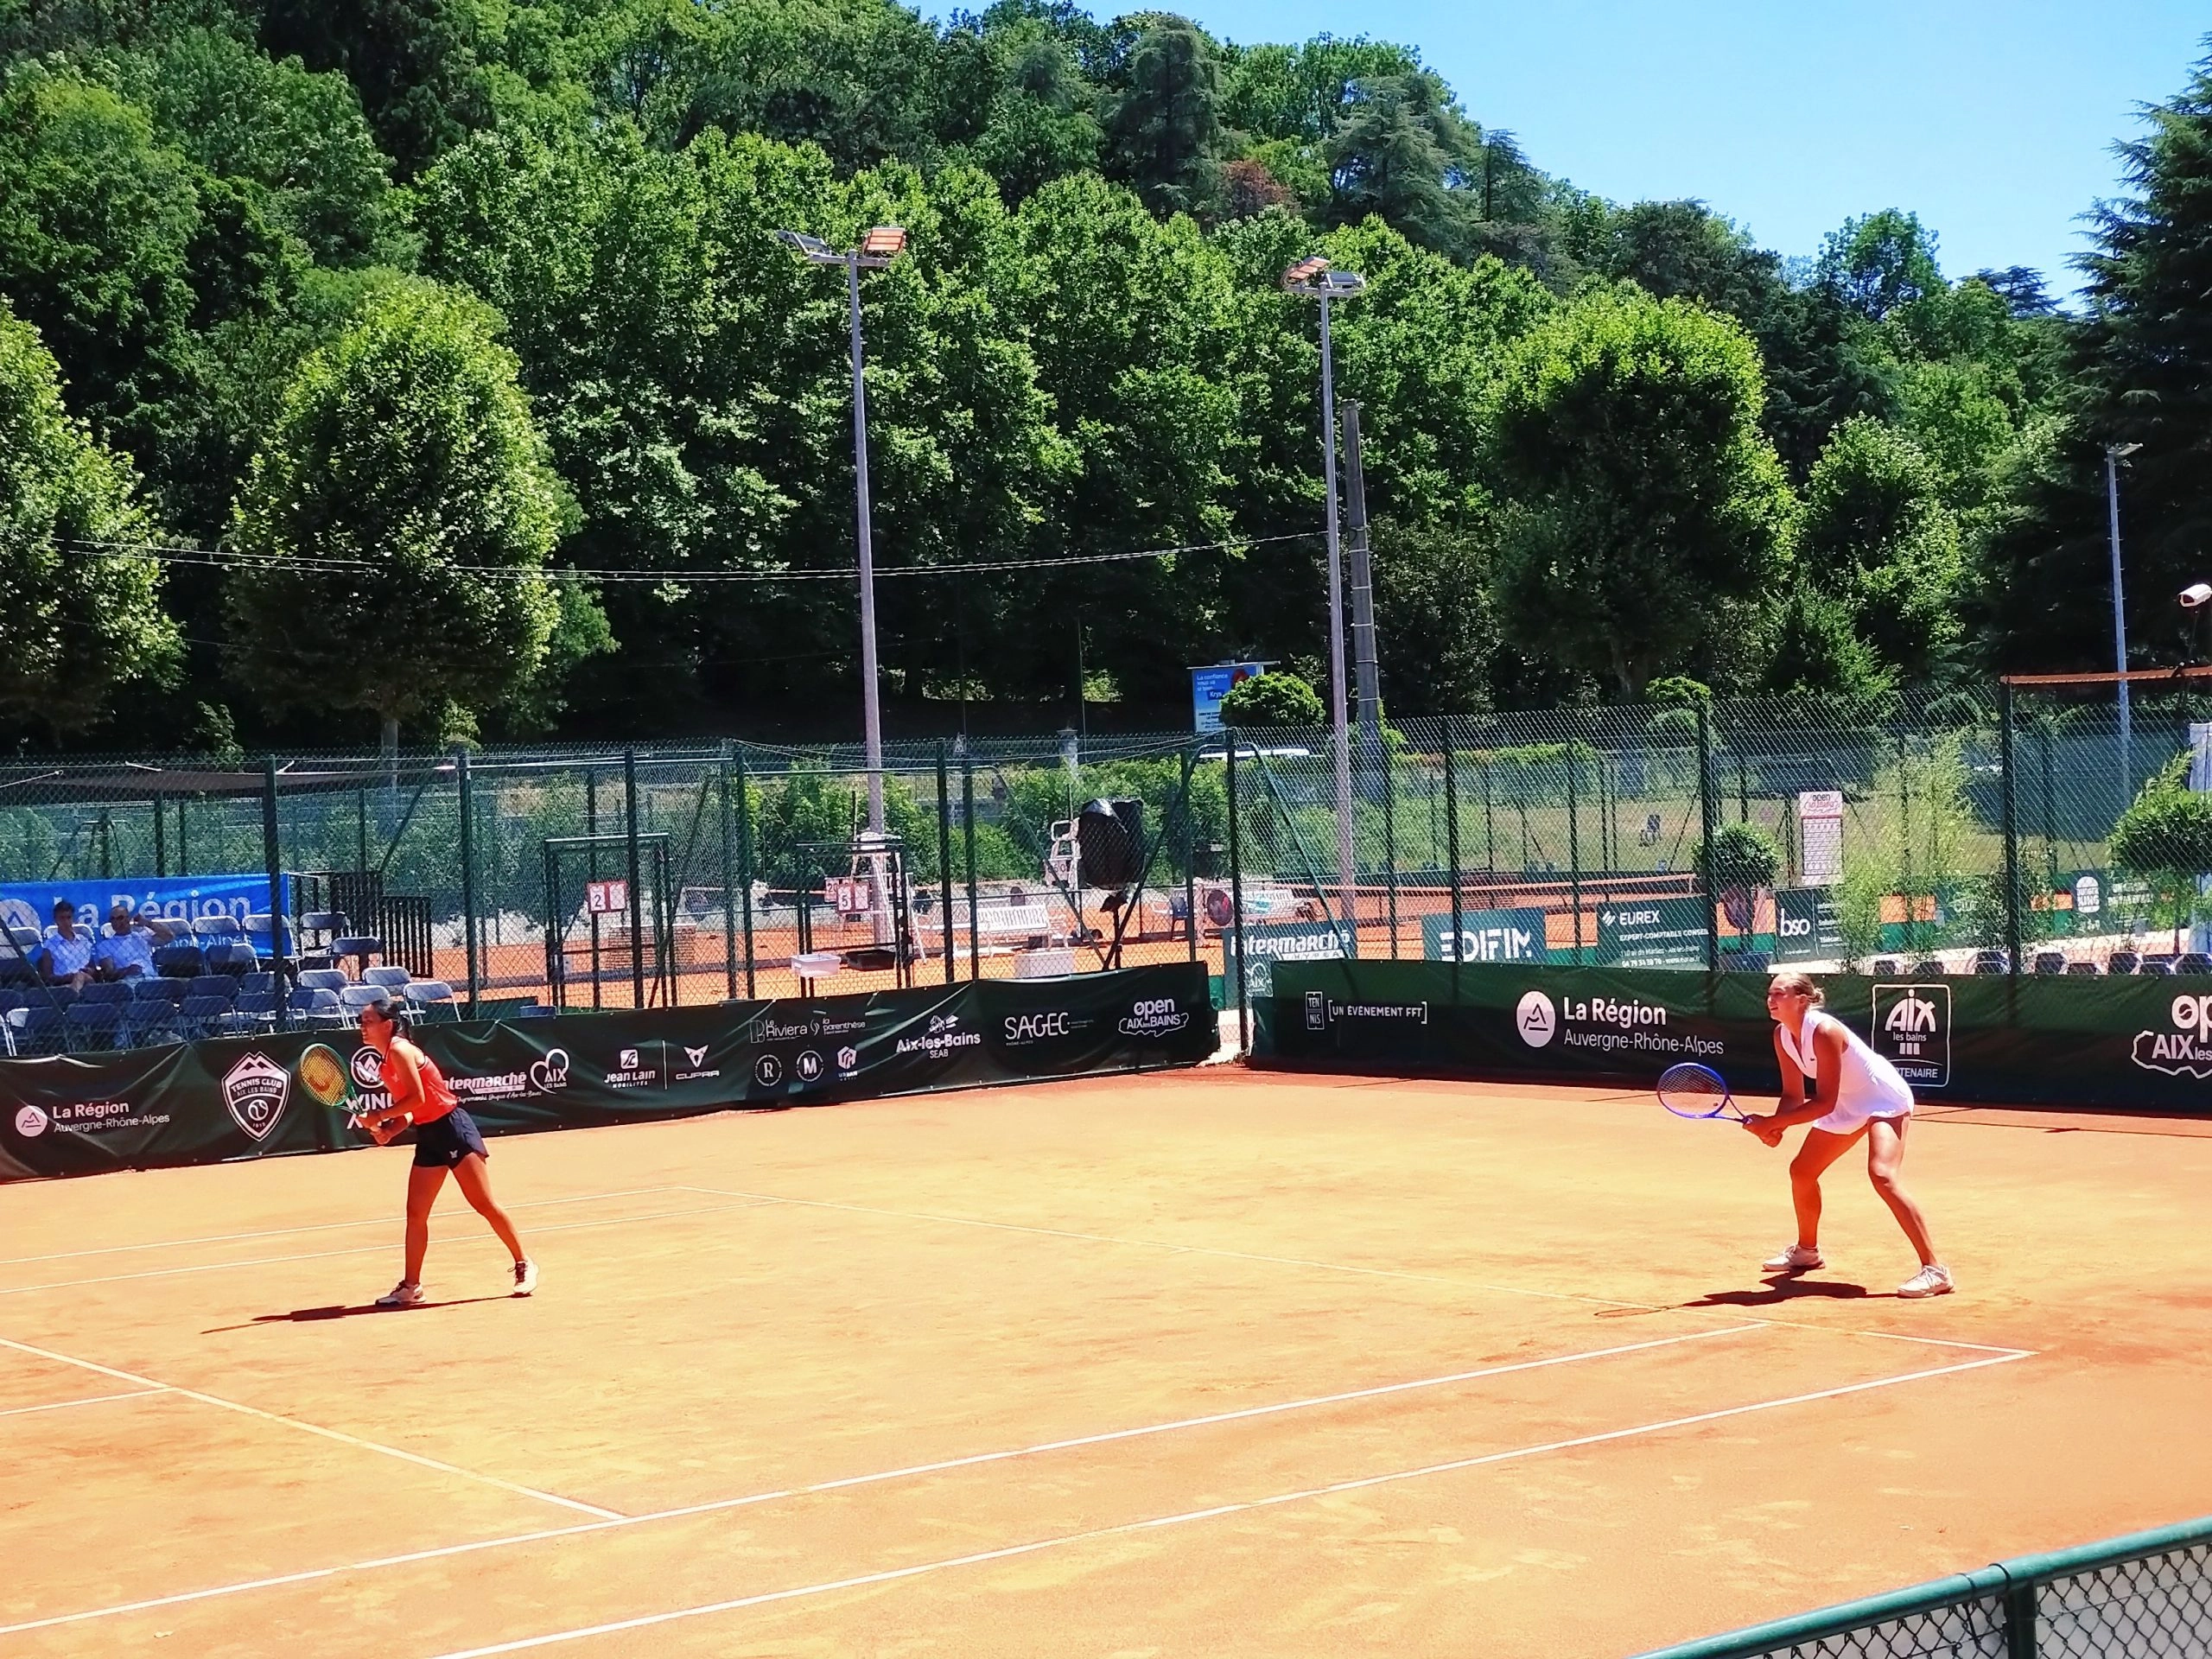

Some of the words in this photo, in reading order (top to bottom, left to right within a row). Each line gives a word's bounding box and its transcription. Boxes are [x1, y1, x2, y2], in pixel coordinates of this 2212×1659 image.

[594, 893, 602, 908] 2
[842, 894, 848, 907] 5
[1619, 910, 1660, 925] EUREX
[1780, 908, 1810, 937] bso
[1440, 928, 1532, 962] EDIFIM
[1134, 998, 1175, 1020] open
[1307, 997, 1320, 1007] TEN
[1406, 1007, 1423, 1017] FFT
[1563, 997, 1587, 1020] La
[1592, 998, 1667, 1029] Région
[1004, 1012, 1070, 1039] SAGEC
[1127, 1017, 1144, 1029] AIX
[1150, 1014, 1181, 1027] BAINS
[766, 1024, 808, 1038] Riviera
[1892, 1032, 1904, 1041] les
[1906, 1032, 1927, 1042] bains
[896, 1032, 981, 1053] Aix-les-Bains
[1564, 1028, 1725, 1057] Auvergne-Rhône-Alpes
[2152, 1033, 2195, 1060] AIX
[930, 1048, 949, 1058] SEAB
[763, 1062, 774, 1078] R
[804, 1057, 817, 1074] M
[1897, 1067, 1939, 1078] TENAIRE
[544, 1068, 566, 1083] AIX
[604, 1072, 631, 1084] Jean
[676, 1070, 720, 1080] CUPRA
[231, 1077, 260, 1092] TENNIS
[261, 1078, 283, 1088] CLUB
[53, 1105, 71, 1119] La
[75, 1102, 130, 1118] Région
[54, 1114, 170, 1133] Auvergne-Rhône-Alpes
